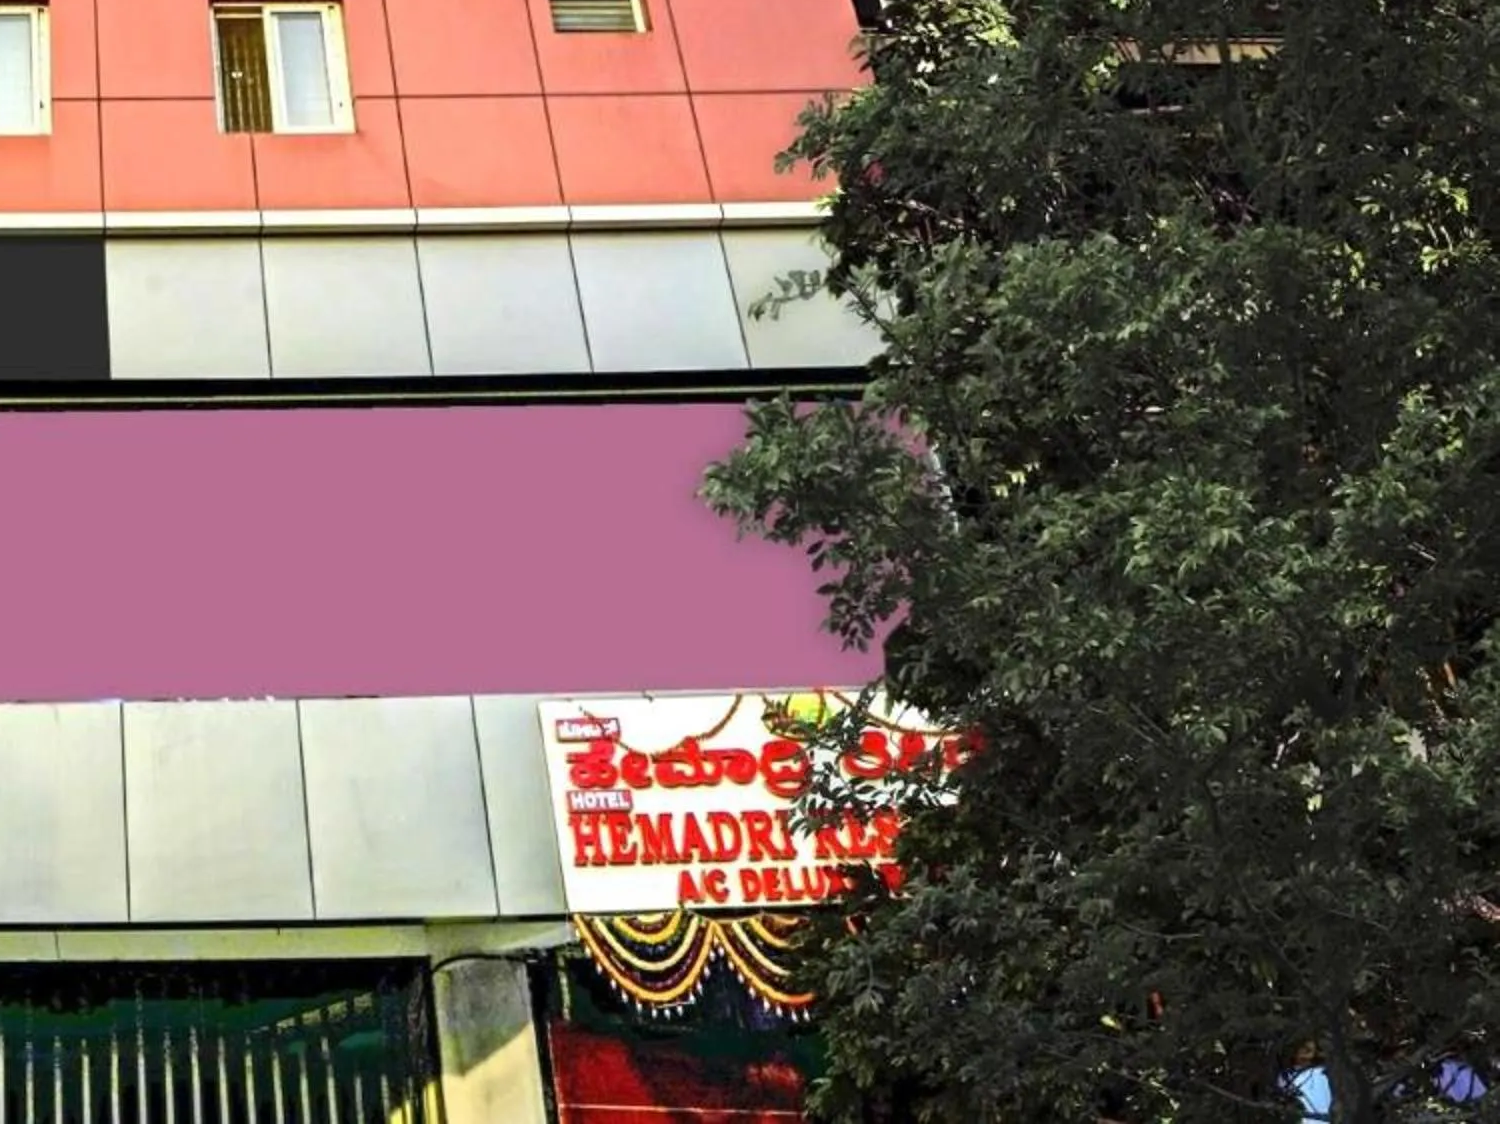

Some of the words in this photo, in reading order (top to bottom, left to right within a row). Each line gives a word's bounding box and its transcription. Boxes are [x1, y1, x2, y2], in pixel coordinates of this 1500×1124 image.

[572, 791, 630, 810] HOTEL
[567, 808, 797, 867] HEMADRI
[809, 805, 902, 859] RES
[739, 864, 854, 903] DELUX
